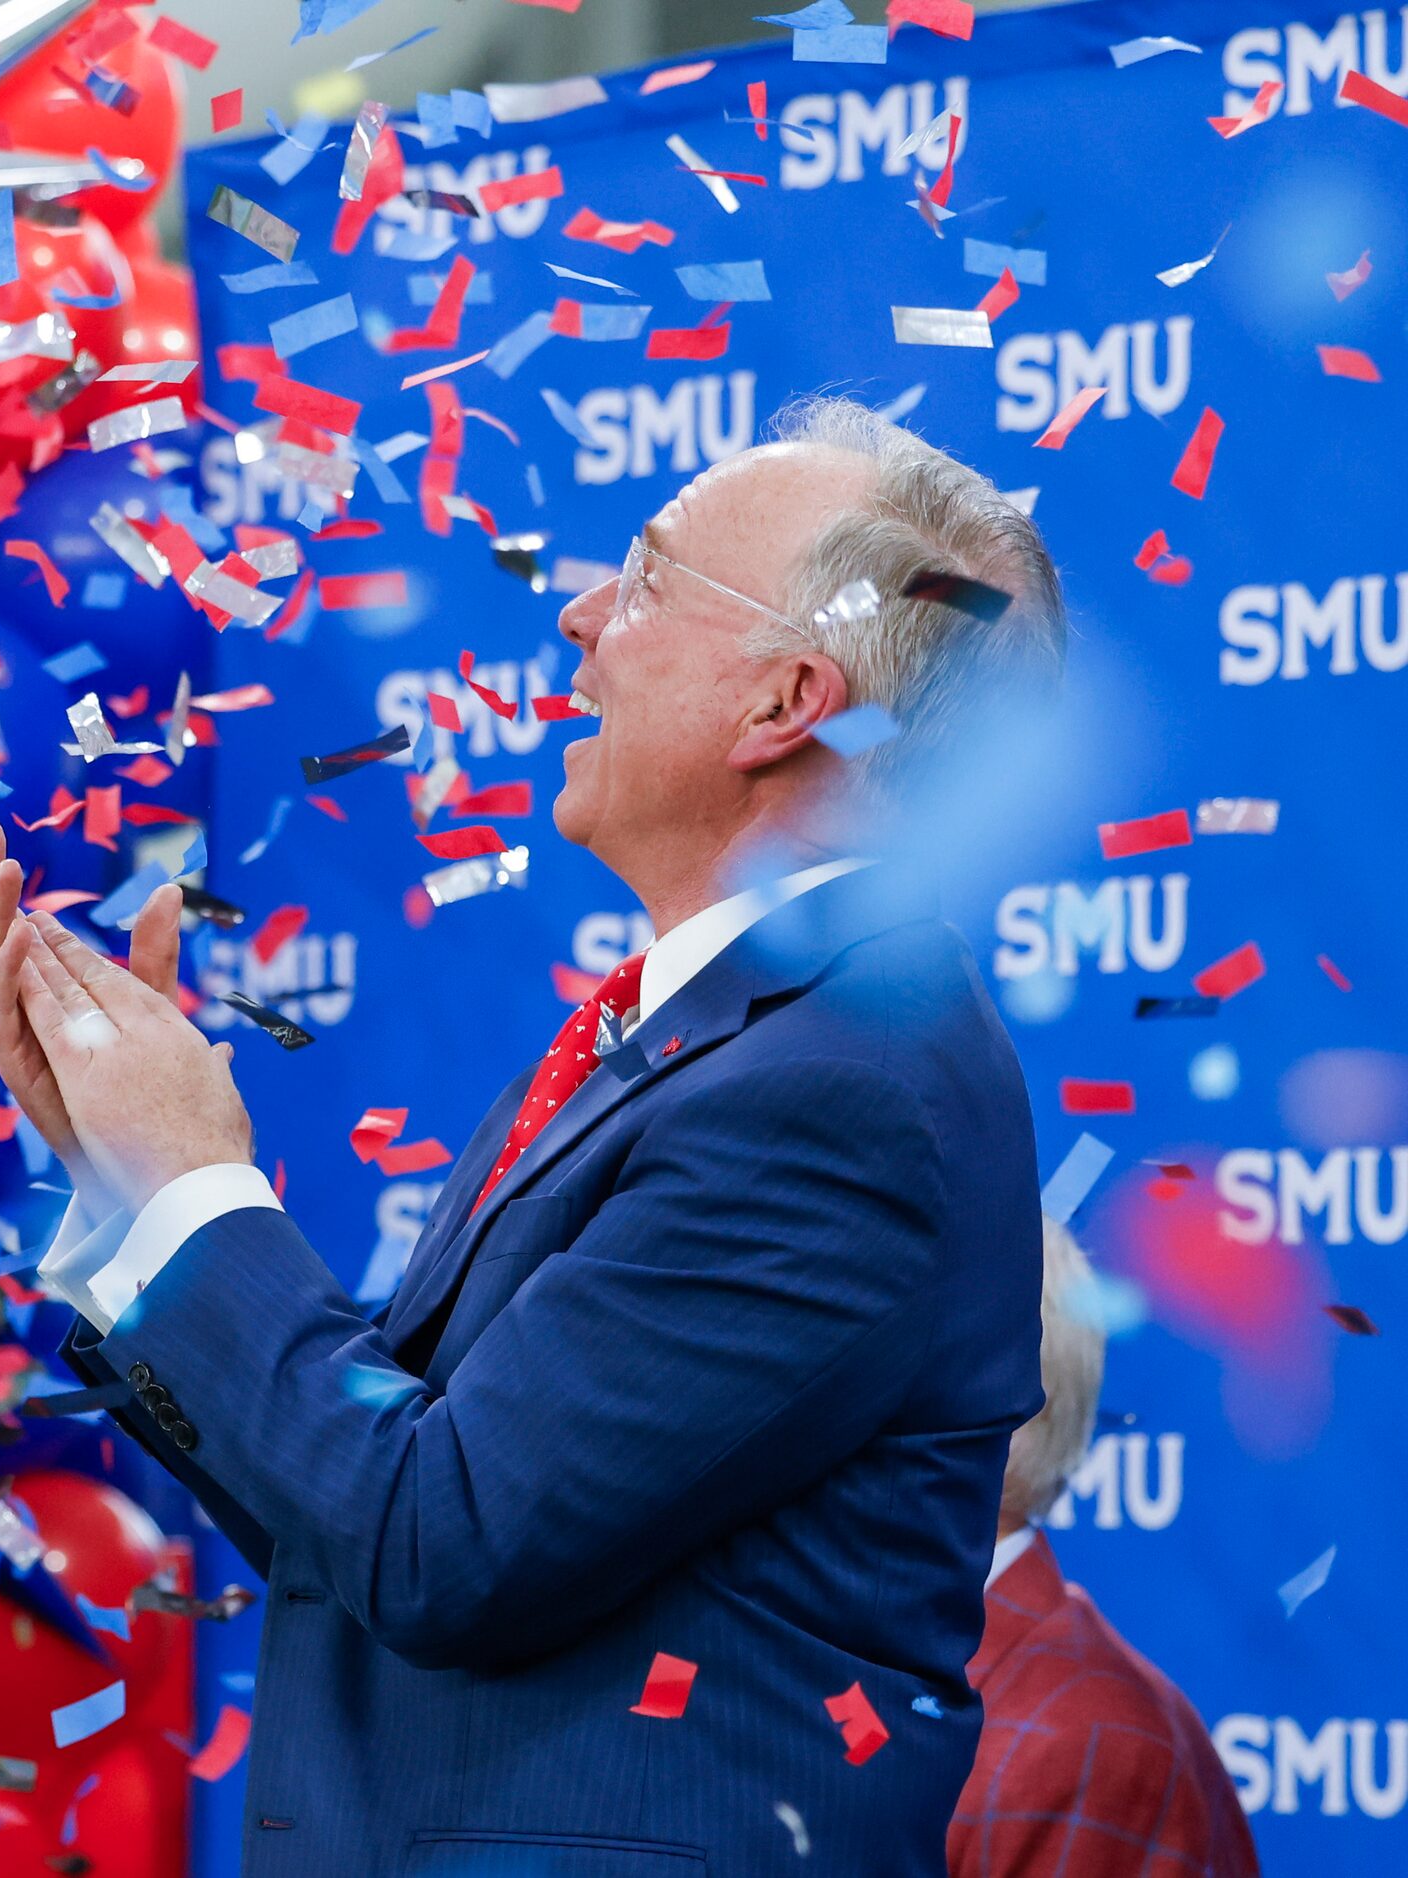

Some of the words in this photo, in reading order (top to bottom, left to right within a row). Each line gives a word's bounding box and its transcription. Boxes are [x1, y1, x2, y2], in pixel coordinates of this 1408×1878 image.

[1222, 5, 1408, 120] SMU
[780, 77, 969, 190] SMU
[574, 371, 756, 486] SMU
[995, 315, 1194, 433] SMU
[1219, 572, 1408, 685] SMU
[375, 659, 552, 766] SMU
[994, 873, 1191, 980] SMU
[1216, 1147, 1408, 1245] SMU
[1028, 1432, 1185, 1531] MU
[1213, 1713, 1408, 1820] SMU
